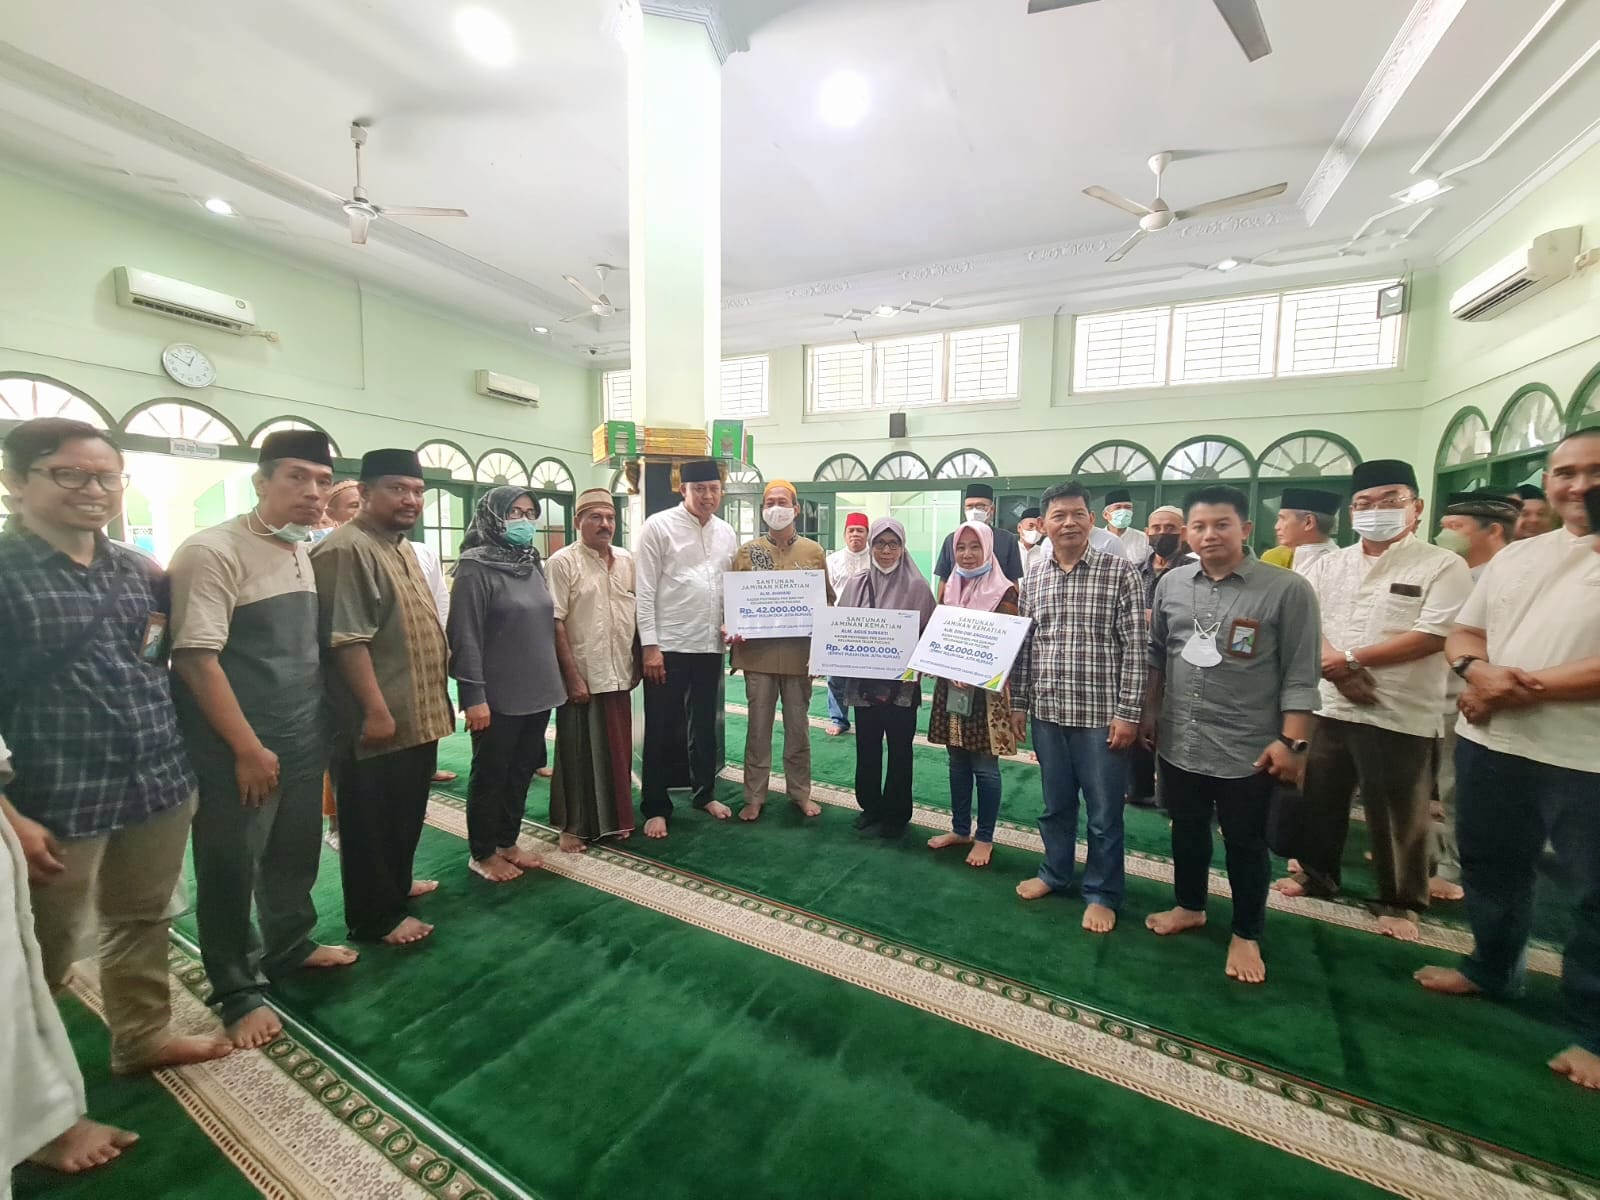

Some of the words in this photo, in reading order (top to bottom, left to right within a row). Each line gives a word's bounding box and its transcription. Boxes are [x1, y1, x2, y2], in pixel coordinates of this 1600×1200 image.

[739, 607, 754, 615] Rp.
[756, 605, 813, 614] 42.000.000,-
[943, 620, 972, 629] JAMINAN
[973, 624, 1007, 634] KEMATIAN
[959, 617, 994, 626] SANTUNAN
[843, 644, 903, 655] 42.000.000,-
[929, 641, 942, 649] Rp.
[944, 644, 998, 661] 42.000.000,-
